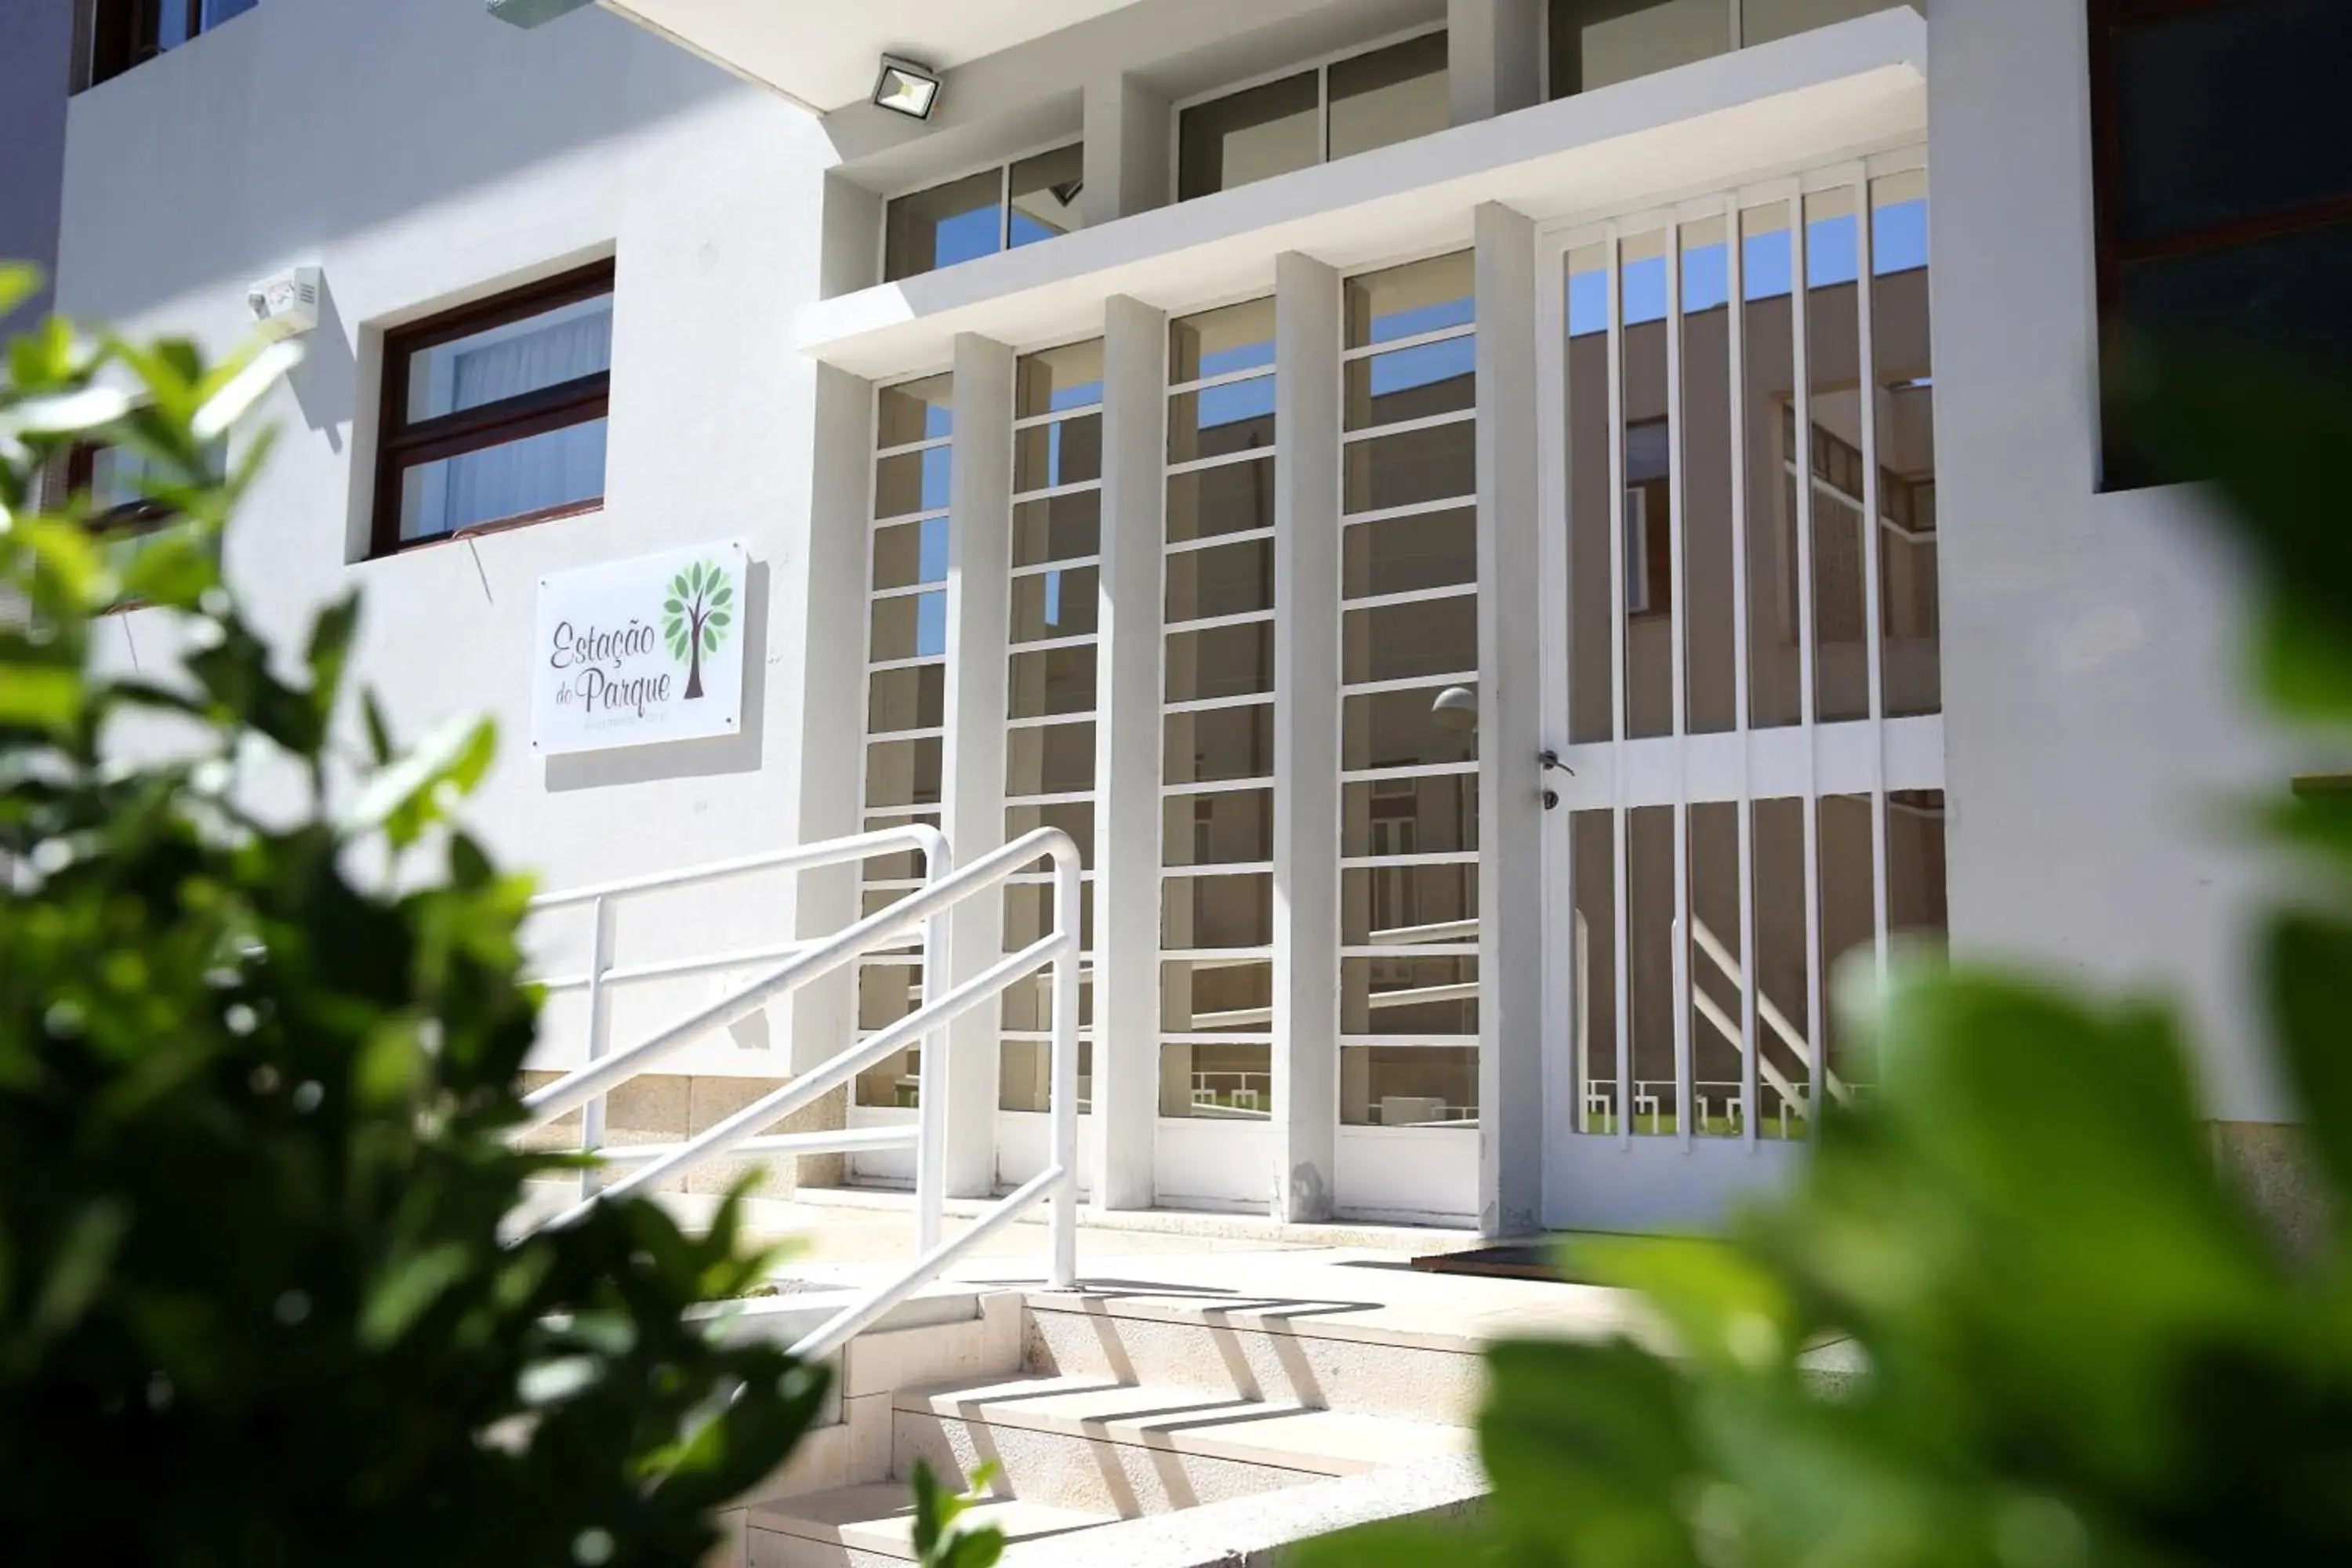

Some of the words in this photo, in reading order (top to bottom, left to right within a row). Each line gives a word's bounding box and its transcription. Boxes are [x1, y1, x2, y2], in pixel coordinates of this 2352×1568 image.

[550, 619, 655, 669] Estação
[556, 681, 573, 705] do
[575, 667, 670, 718] Parque
